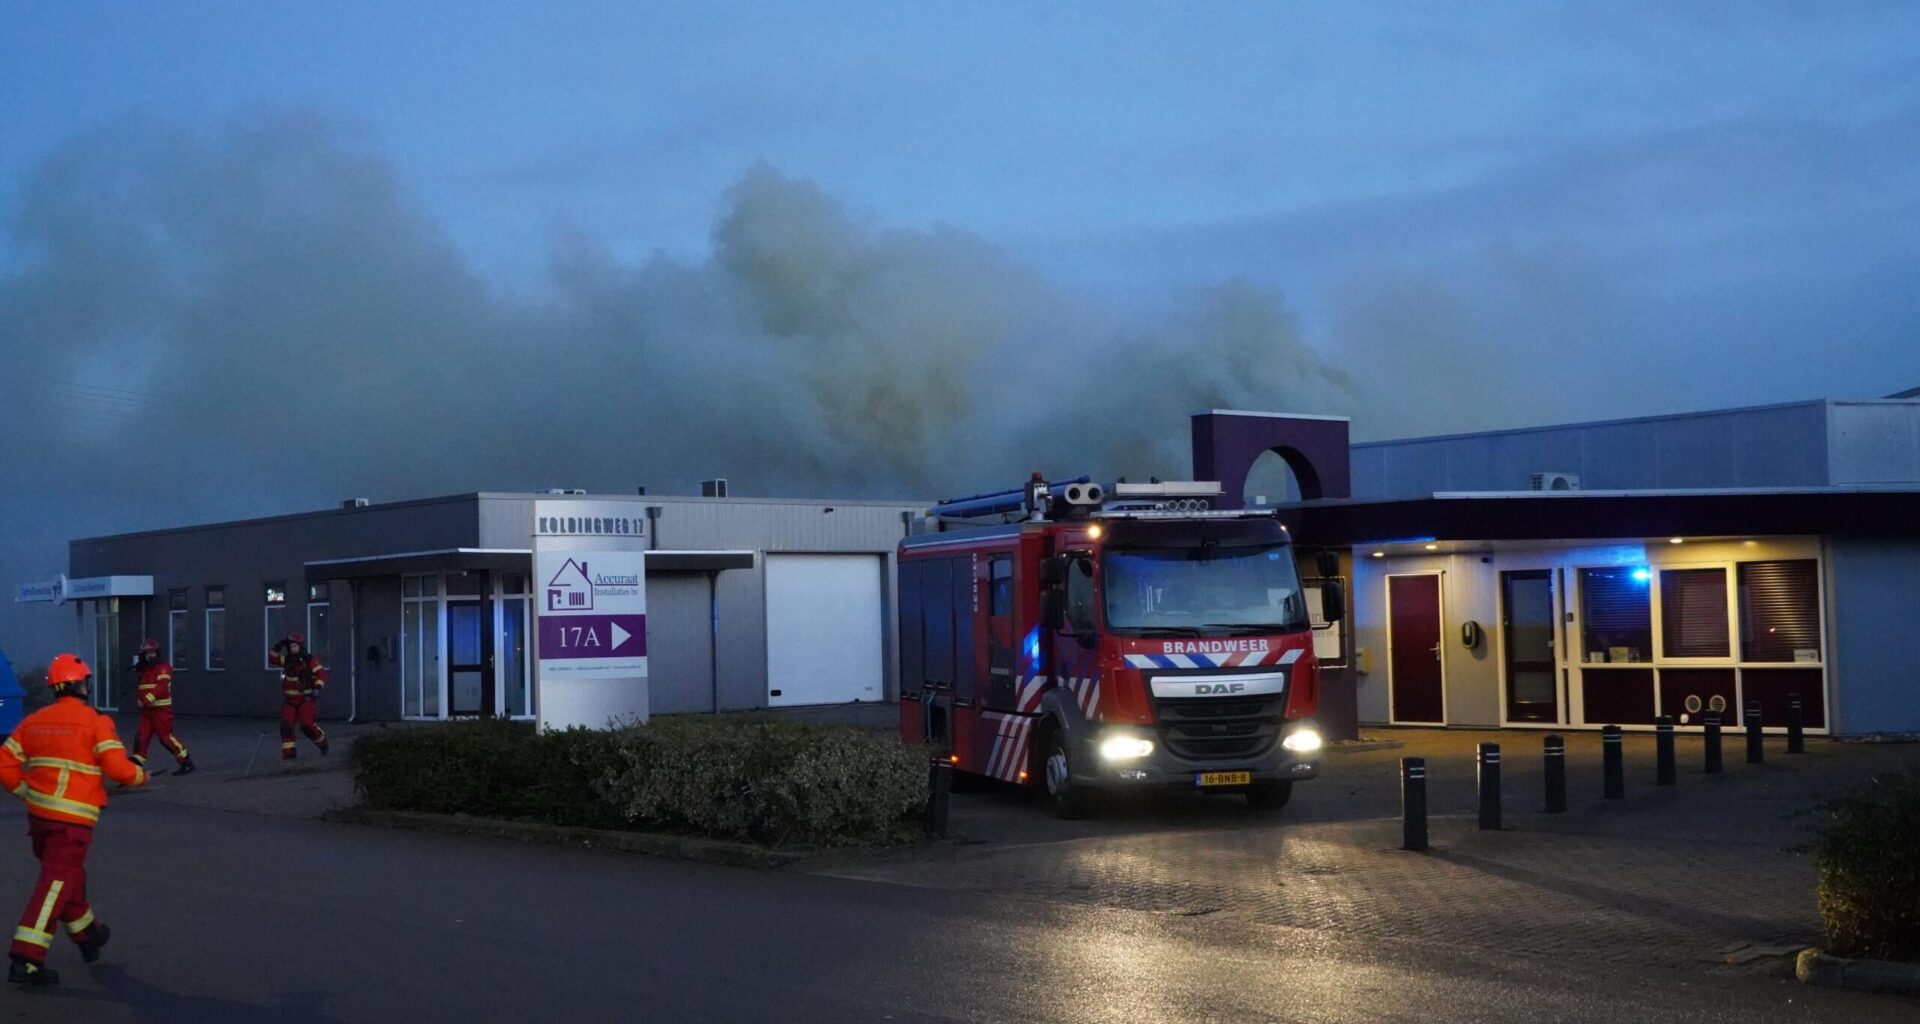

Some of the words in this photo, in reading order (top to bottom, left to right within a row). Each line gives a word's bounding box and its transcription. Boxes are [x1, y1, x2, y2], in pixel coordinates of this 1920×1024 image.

[539, 517, 629, 534] KOLDINGWEG
[632, 518, 644, 534] 17
[594, 572, 639, 584] Accuraat
[594, 587, 630, 596] Installaties
[560, 626, 601, 648] 17A
[1163, 639, 1270, 654] BRANDWEER
[1195, 683, 1245, 695] DAF
[1204, 773, 1247, 785] 16-BNB-8
